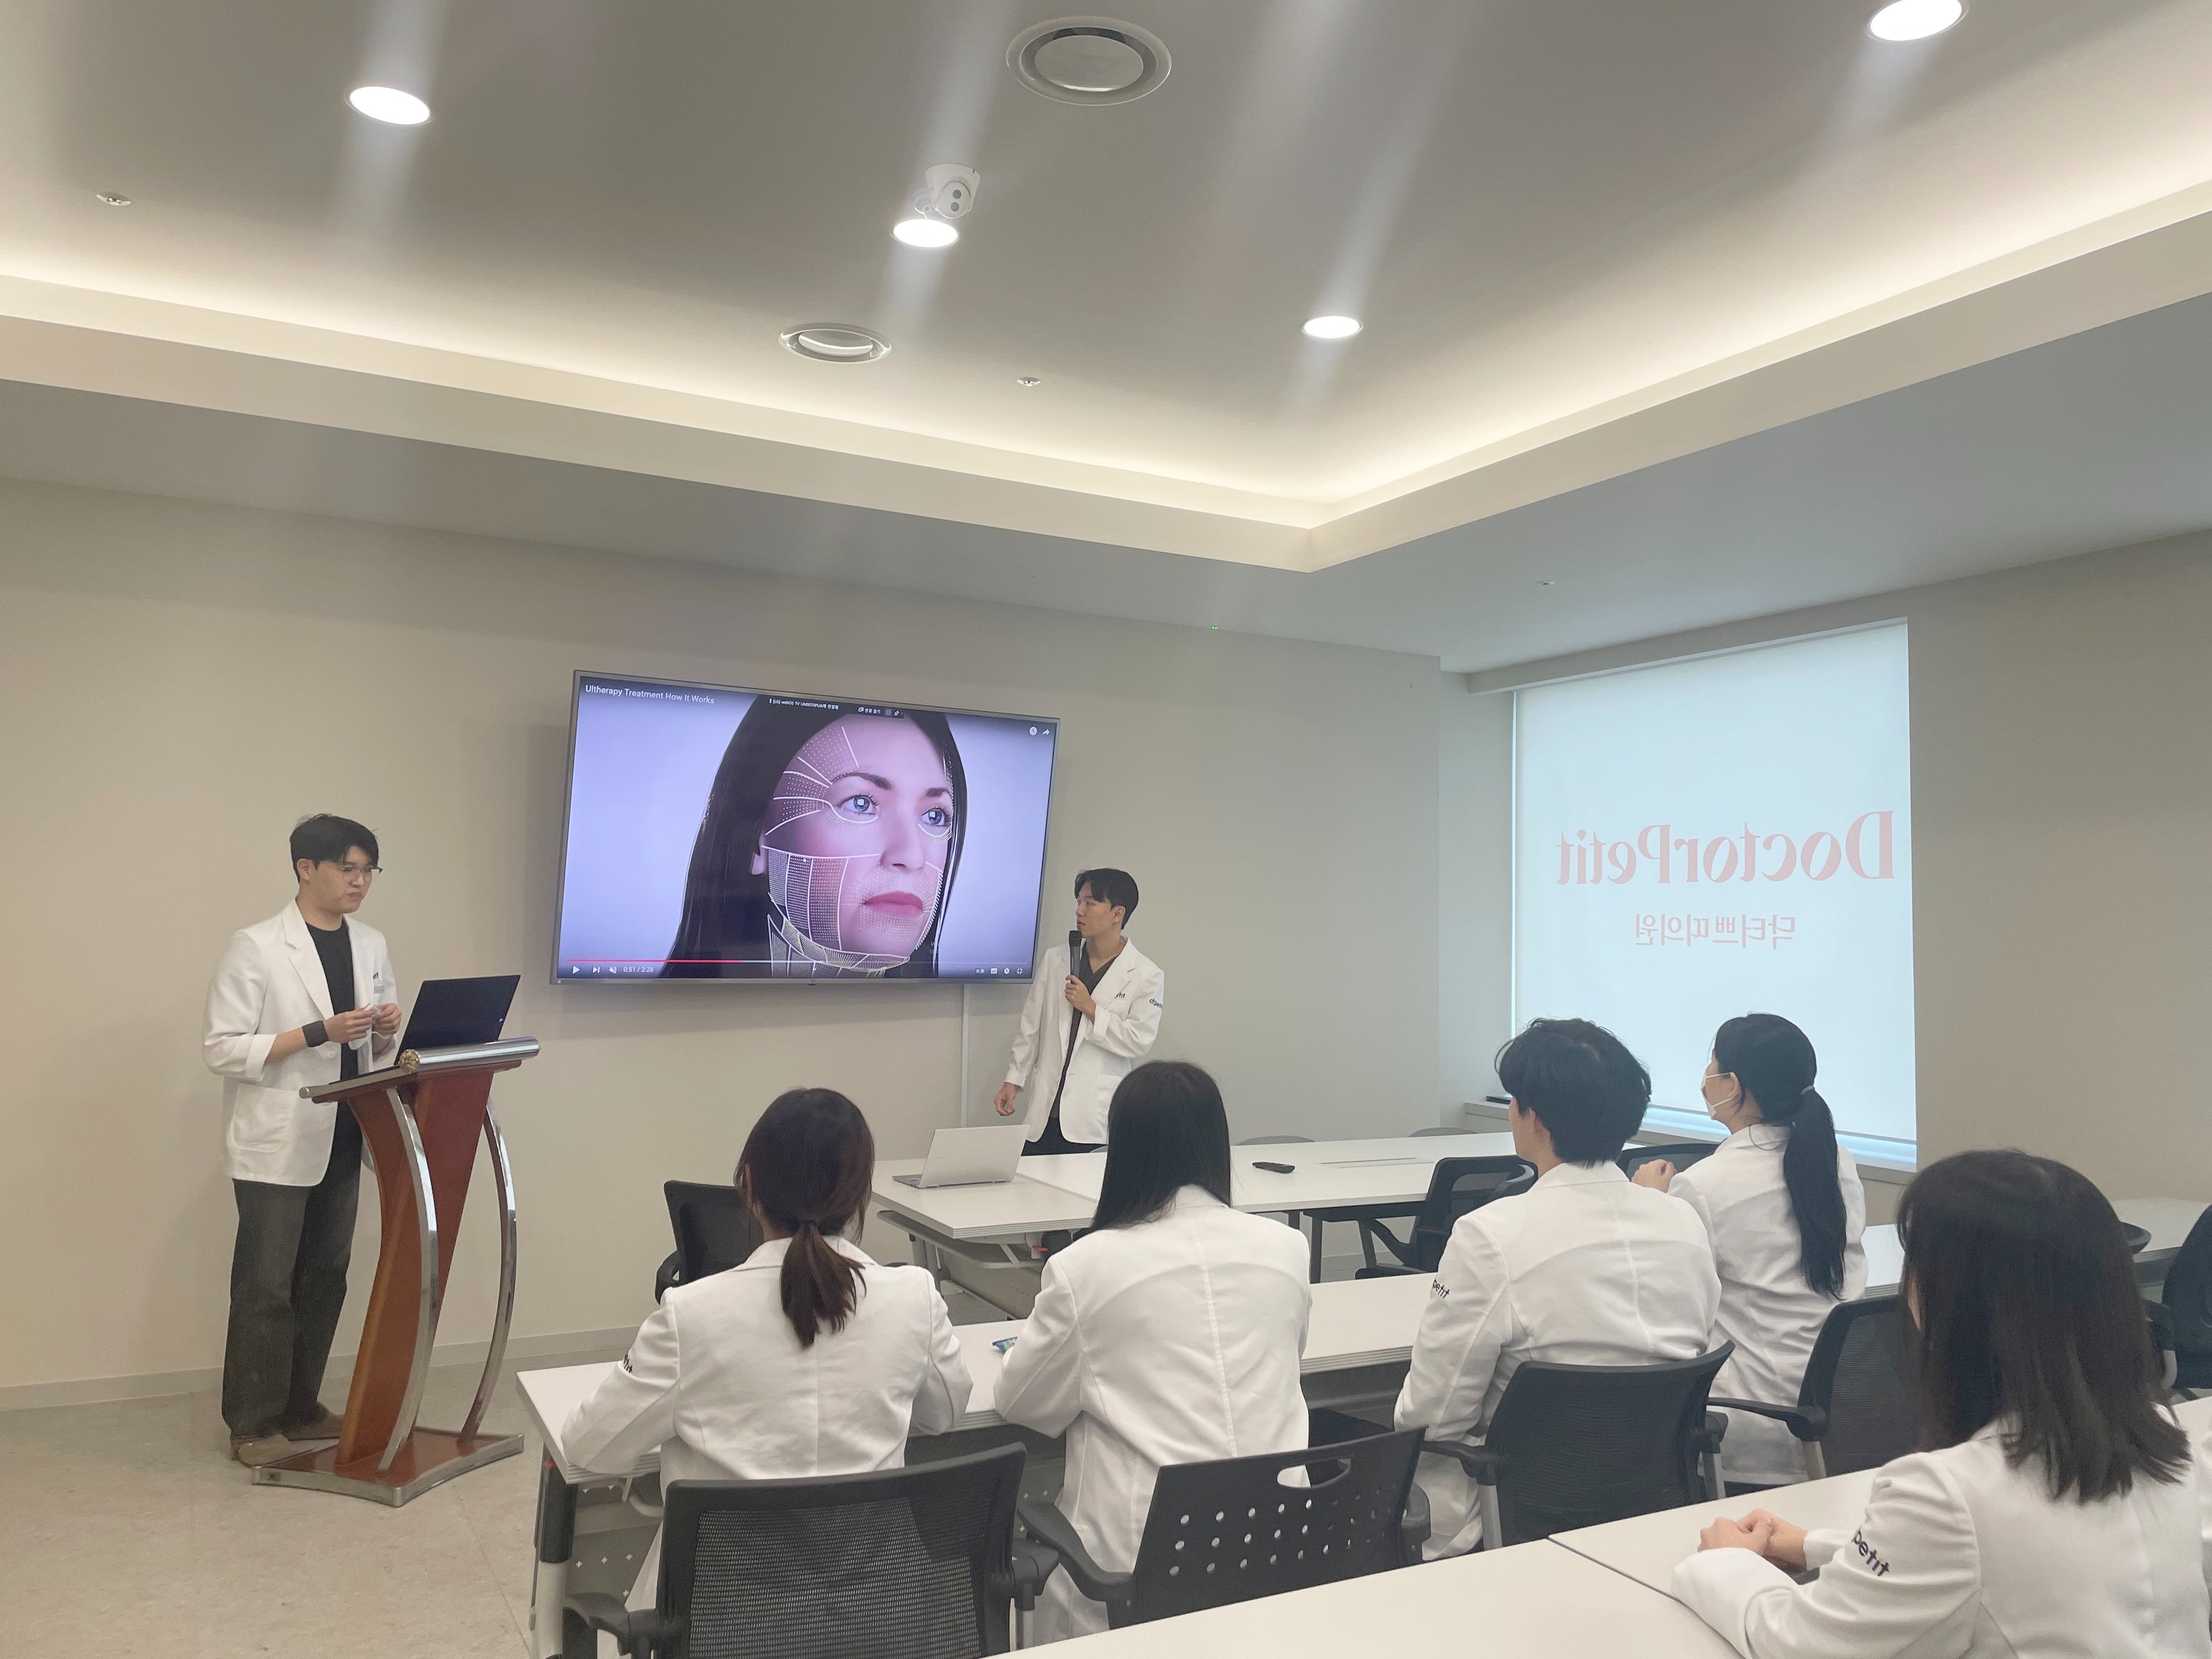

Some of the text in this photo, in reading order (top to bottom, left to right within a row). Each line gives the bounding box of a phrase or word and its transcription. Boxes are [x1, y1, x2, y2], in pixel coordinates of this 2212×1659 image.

[585, 685, 623, 697] Ultherapy
[624, 688, 663, 699] Treatment
[665, 692, 682, 701] How
[692, 695, 715, 704] Works
[1851, 1530, 1889, 1576] petit
